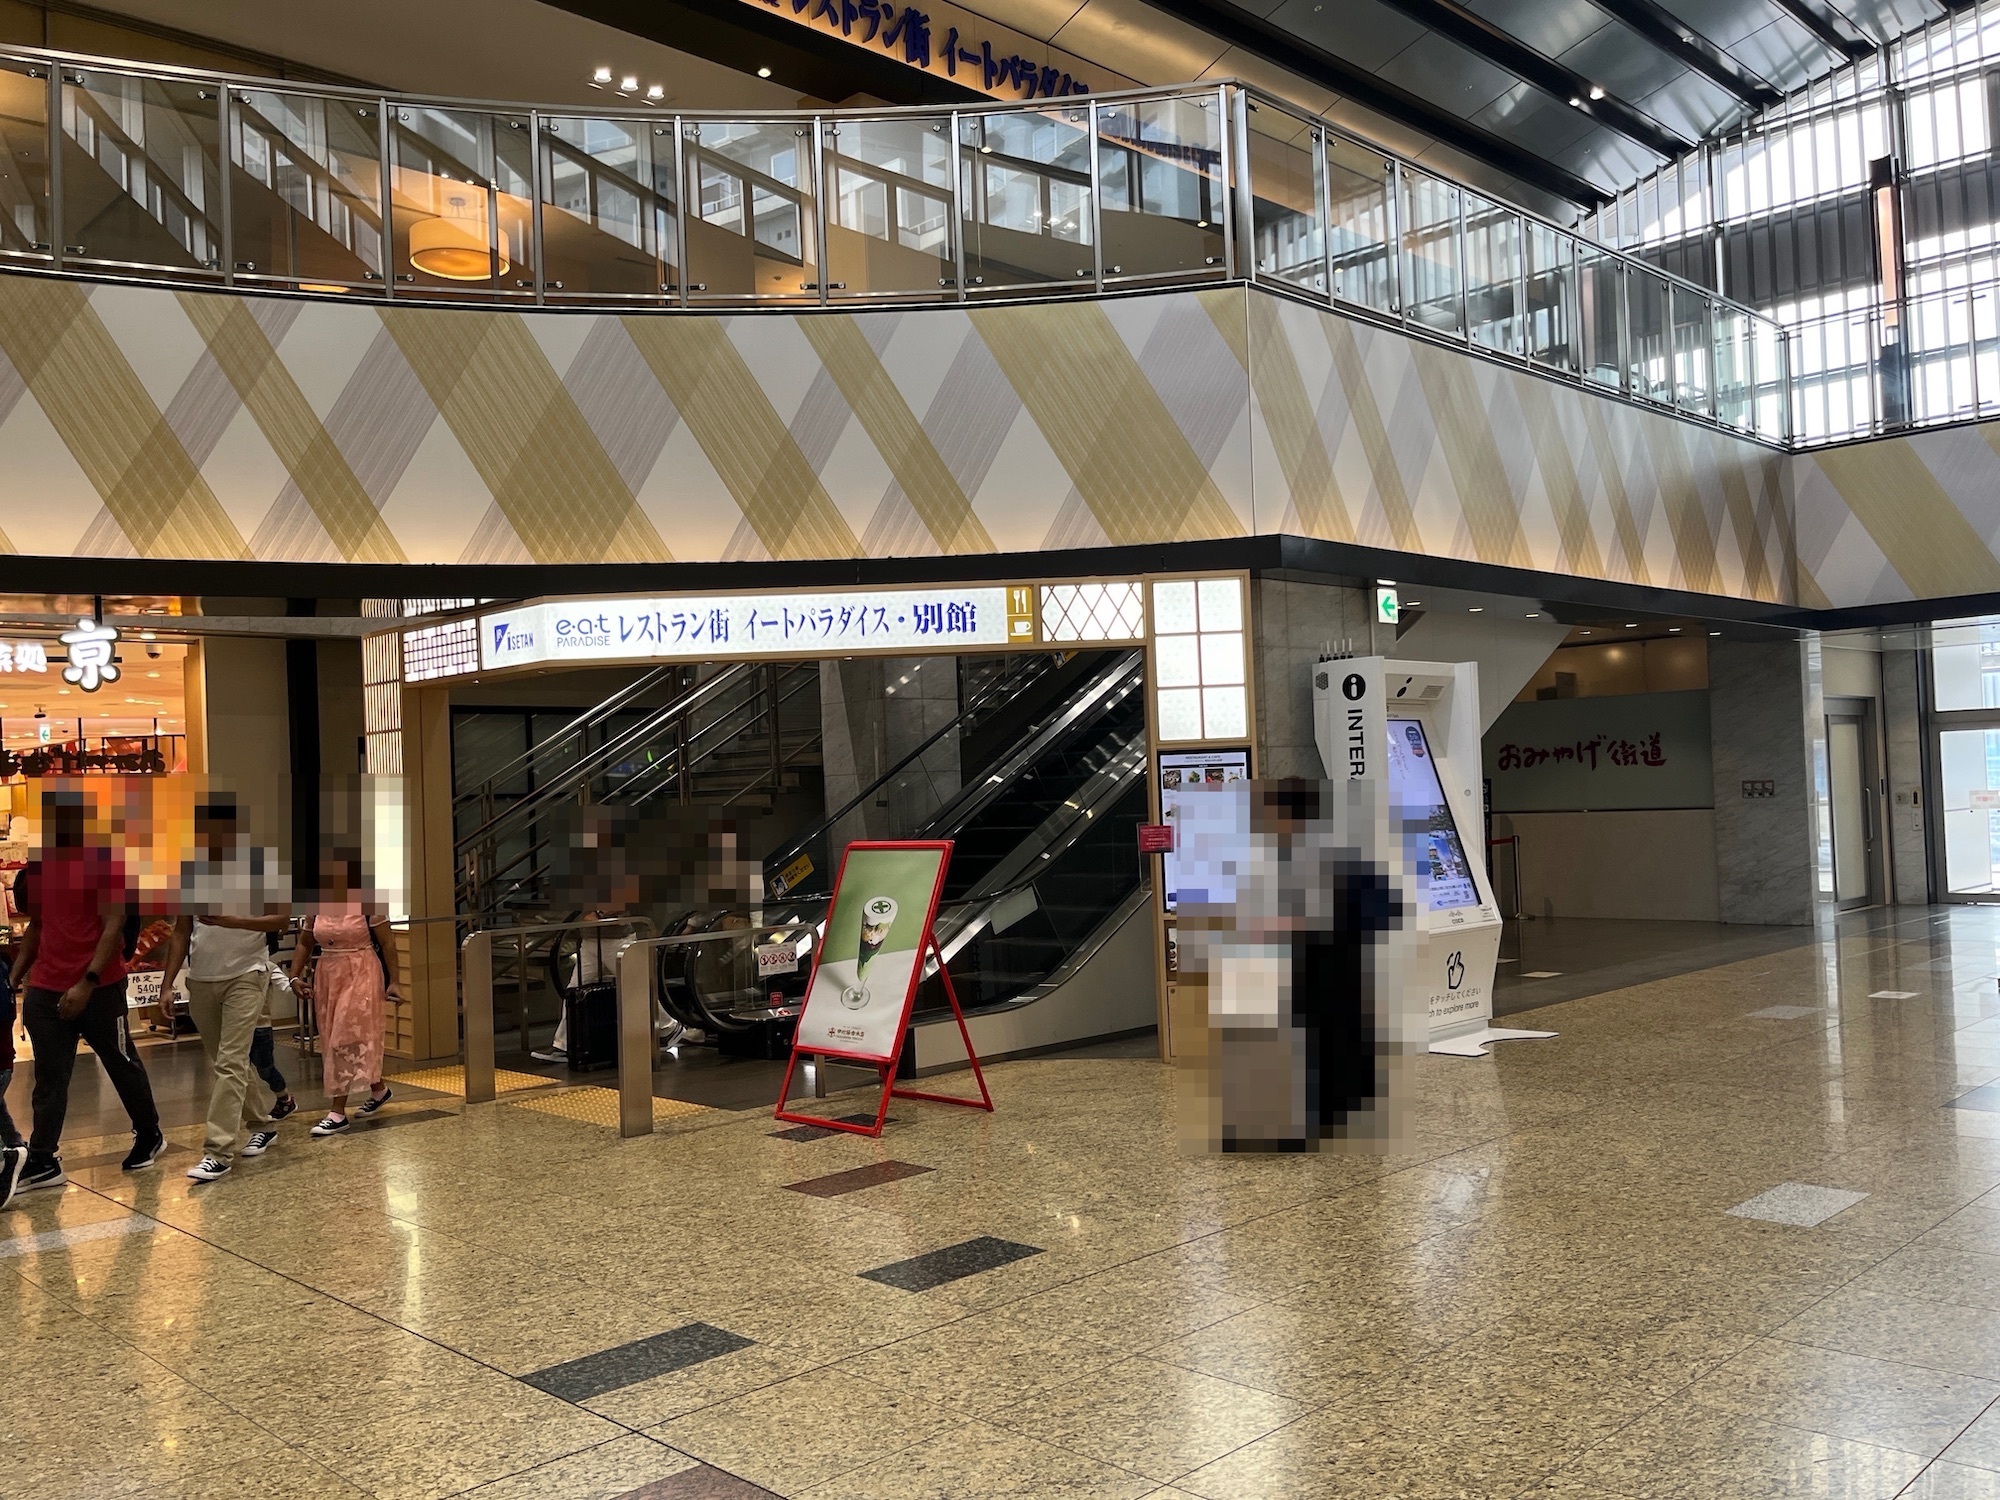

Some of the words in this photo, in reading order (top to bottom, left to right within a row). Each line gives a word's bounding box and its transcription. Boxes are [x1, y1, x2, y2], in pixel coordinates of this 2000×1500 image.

[557, 636, 611, 647] PARADISE
[618, 608, 730, 645] レストラン街
[743, 601, 977, 641] イートパラダイス・別館
[1347, 708, 1366, 780] INTER
[1498, 731, 1667, 772] おみやげ街道
